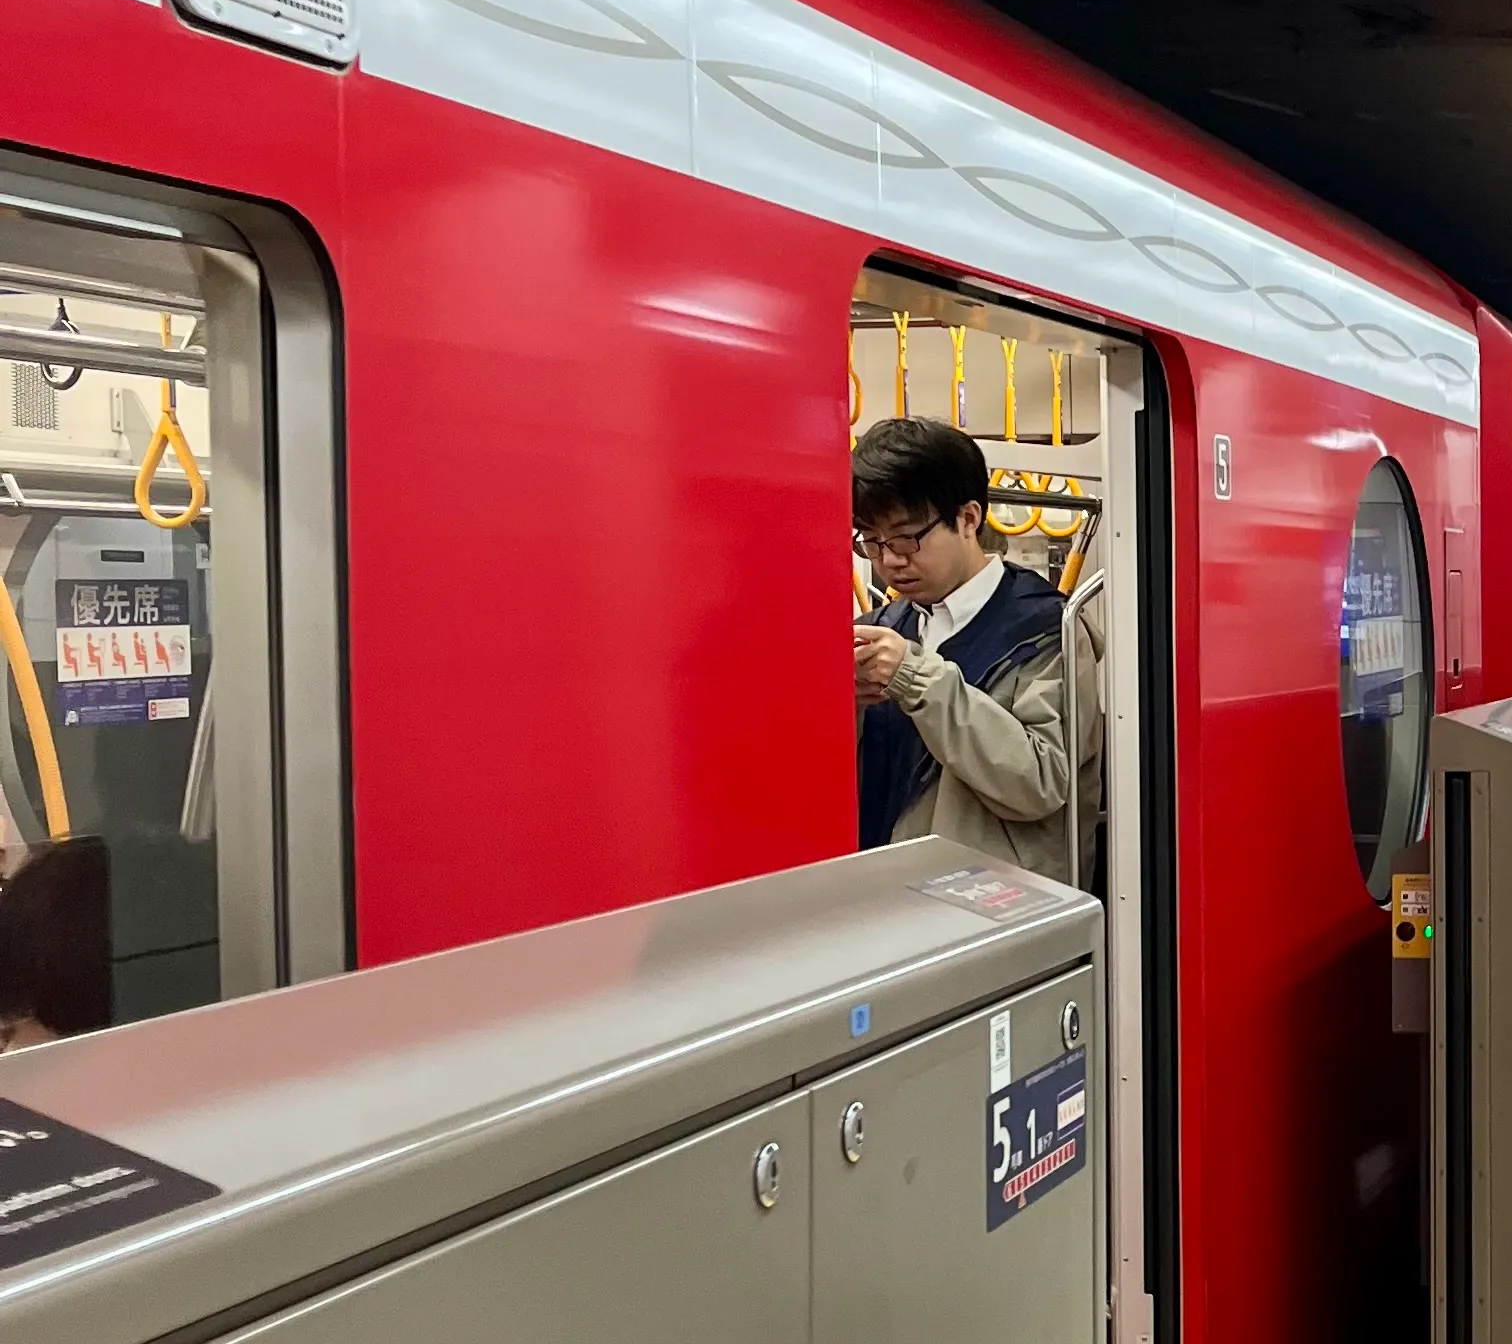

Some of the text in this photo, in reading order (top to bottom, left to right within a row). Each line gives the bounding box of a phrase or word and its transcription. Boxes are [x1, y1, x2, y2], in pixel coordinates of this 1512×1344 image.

[1218, 443, 1228, 492] 5
[70, 583, 160, 627] 優先席
[993, 1096, 1011, 1183] 5
[1026, 1108, 1036, 1159] 1
